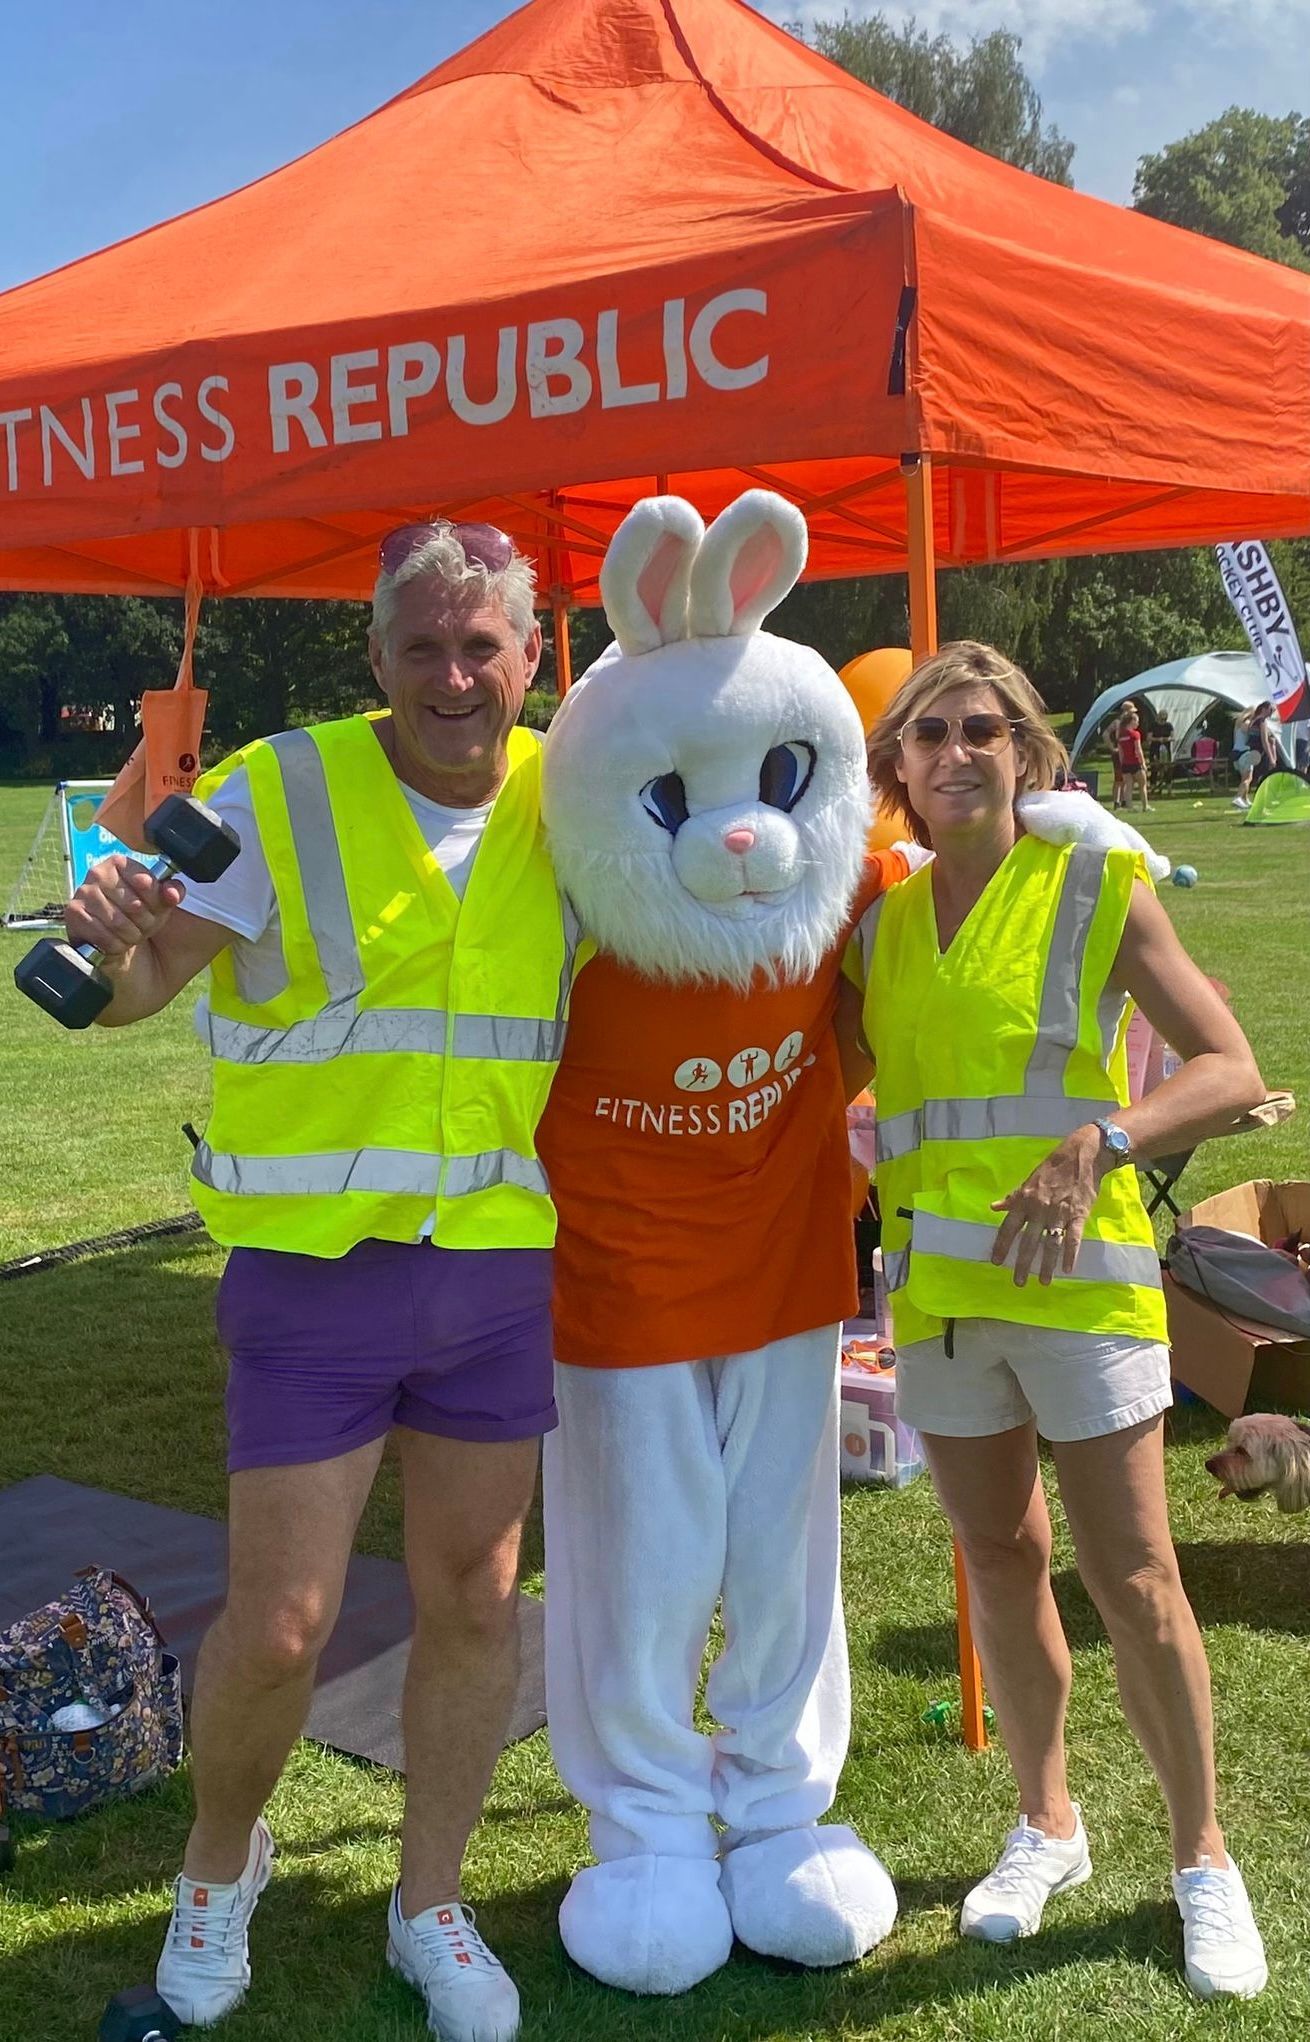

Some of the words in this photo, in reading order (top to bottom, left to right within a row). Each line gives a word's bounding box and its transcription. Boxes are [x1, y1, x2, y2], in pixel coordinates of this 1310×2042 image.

[0, 375, 235, 491] TNESS
[267, 287, 769, 454] REPUBLIC
[1216, 546, 1245, 600] OCKEY
[595, 1097, 721, 1135] FITNESS
